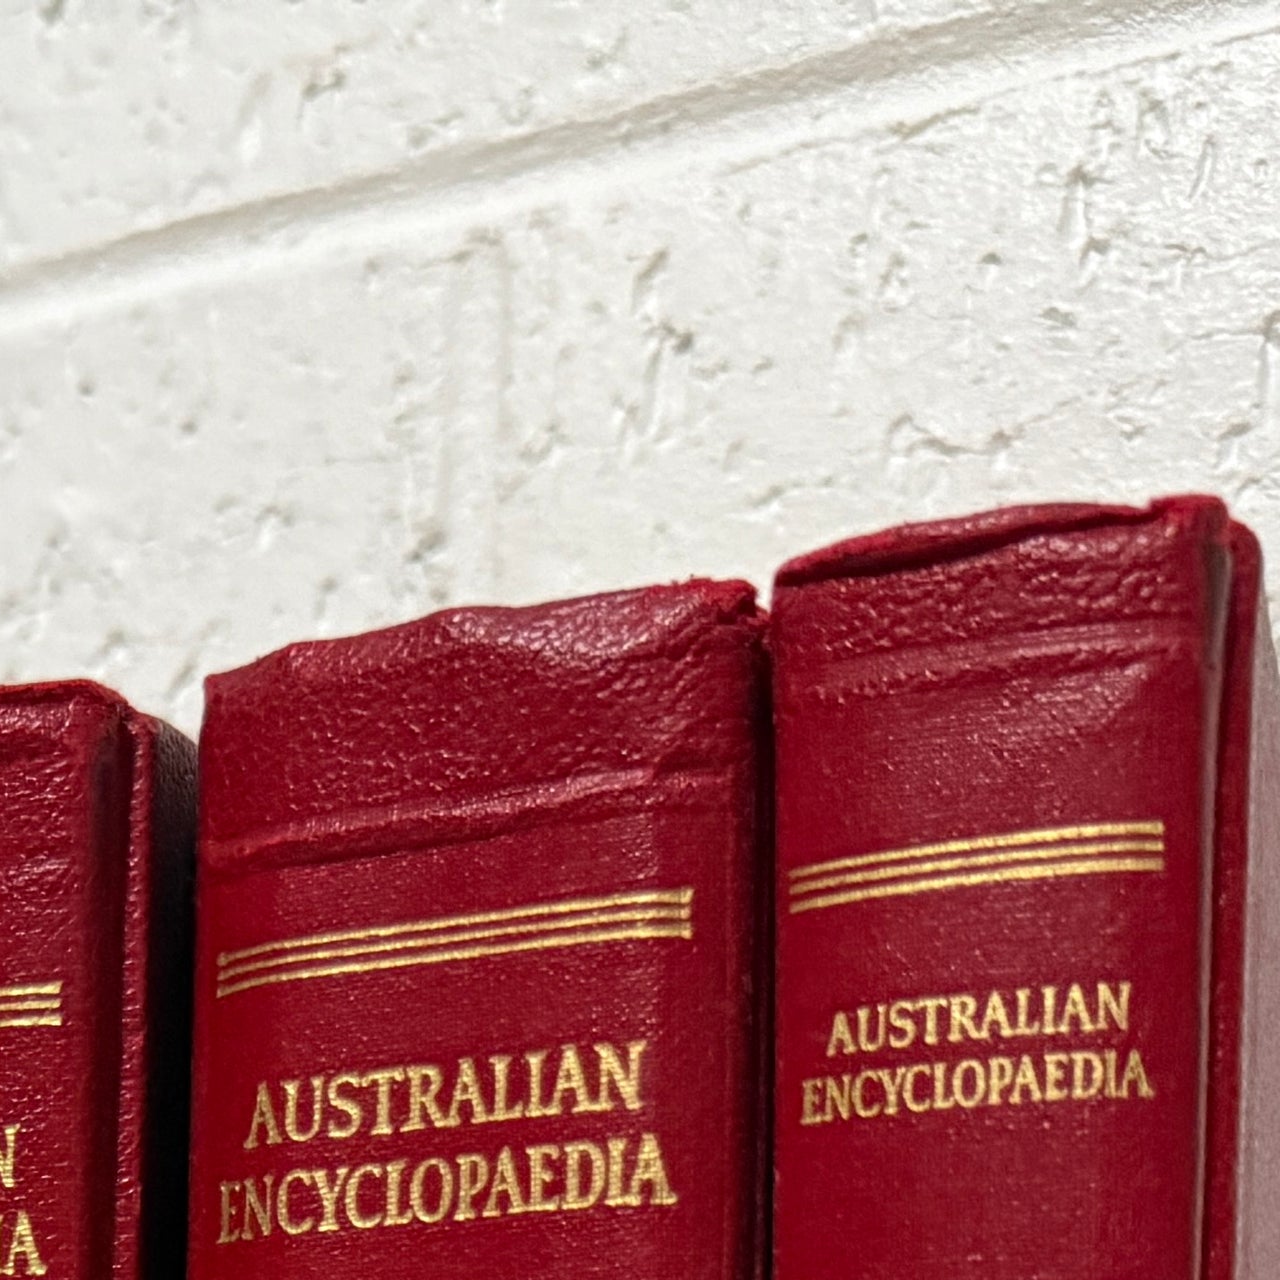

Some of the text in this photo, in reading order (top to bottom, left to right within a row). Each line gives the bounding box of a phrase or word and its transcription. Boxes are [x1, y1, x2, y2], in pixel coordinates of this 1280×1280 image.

[827, 981, 1132, 1057] AUSTRALIAN
[244, 1039, 648, 1150] AUSTRALIAN
[801, 1050, 1154, 1126] ENCYCLOPAEDIA
[218, 1131, 680, 1246] ENCYCLOPAEDIA
